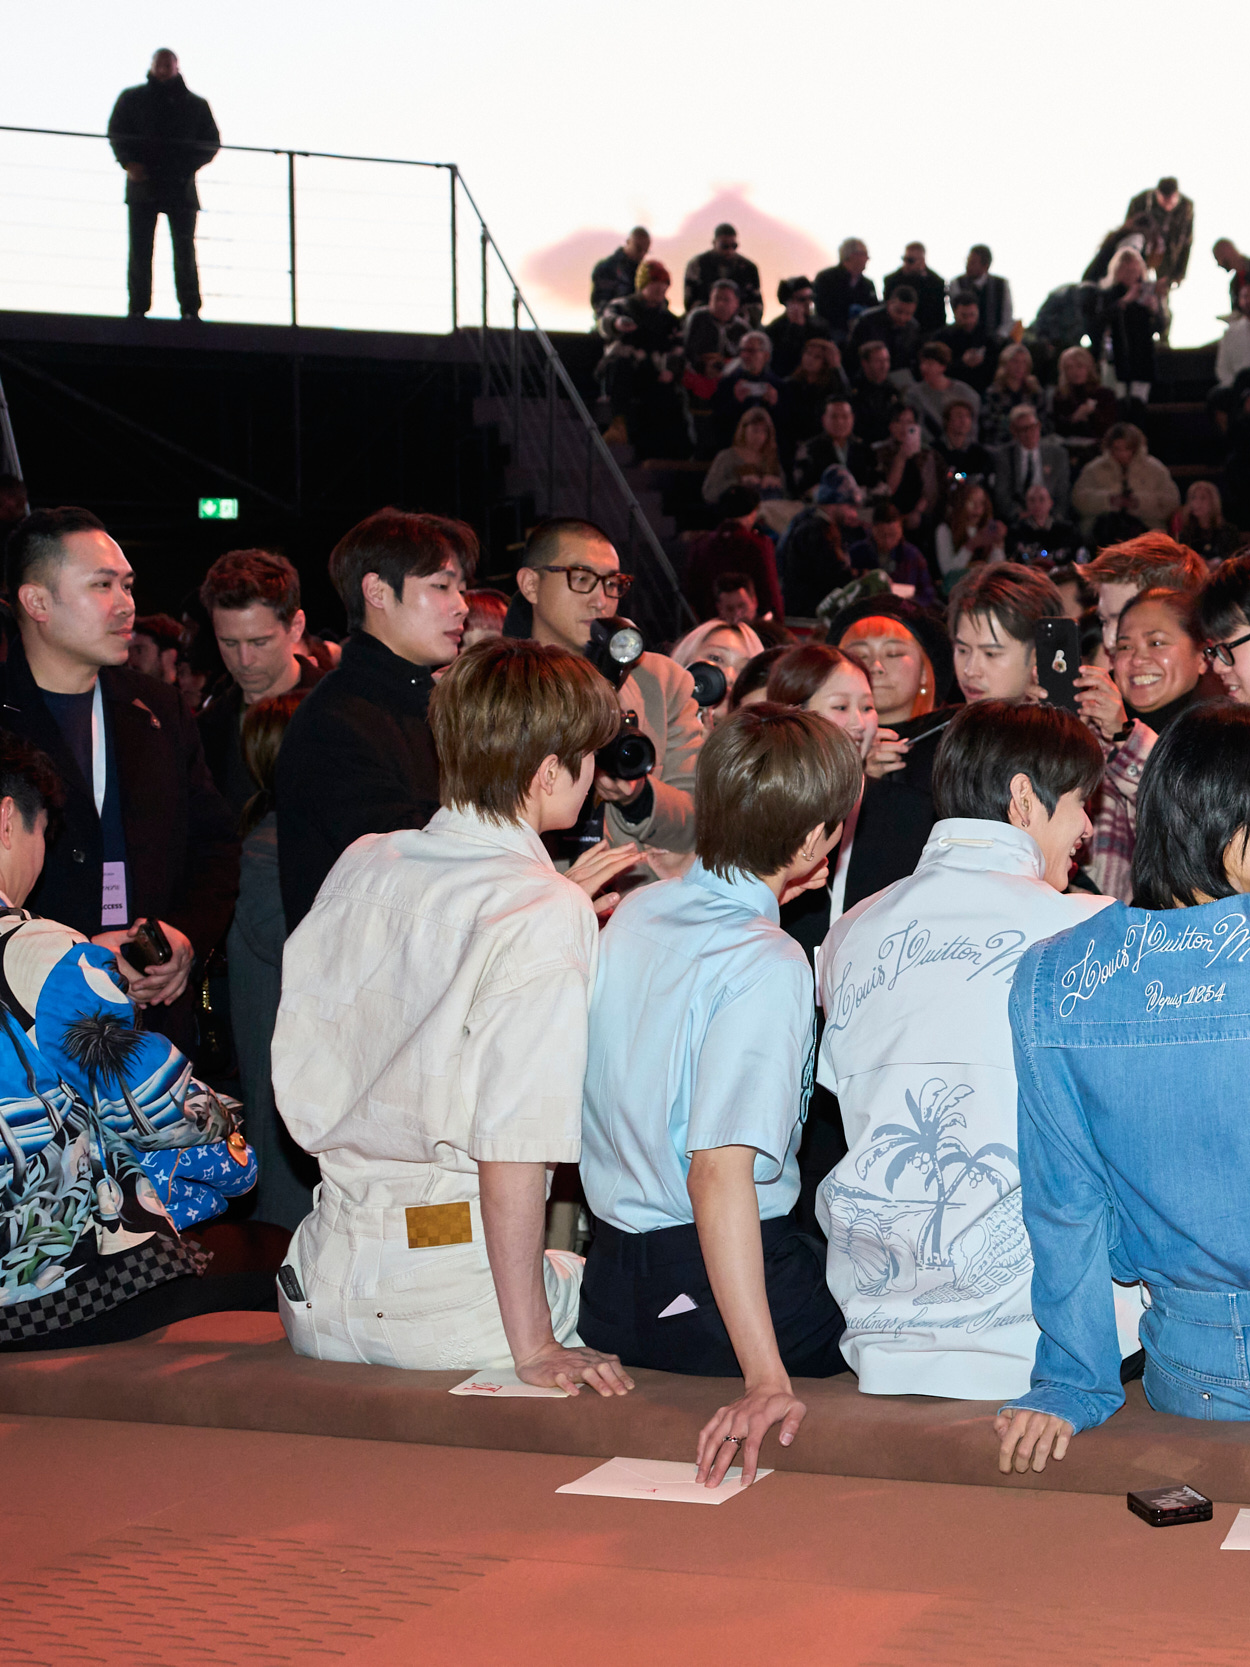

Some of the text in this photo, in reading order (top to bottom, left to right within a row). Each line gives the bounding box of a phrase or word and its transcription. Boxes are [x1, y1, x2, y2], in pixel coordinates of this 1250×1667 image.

[878, 919, 980, 990] Vuitton
[1059, 939, 1129, 1017] Louis
[1124, 913, 1214, 973] Vuitton
[1145, 980, 1226, 1014] Depuis 1854
